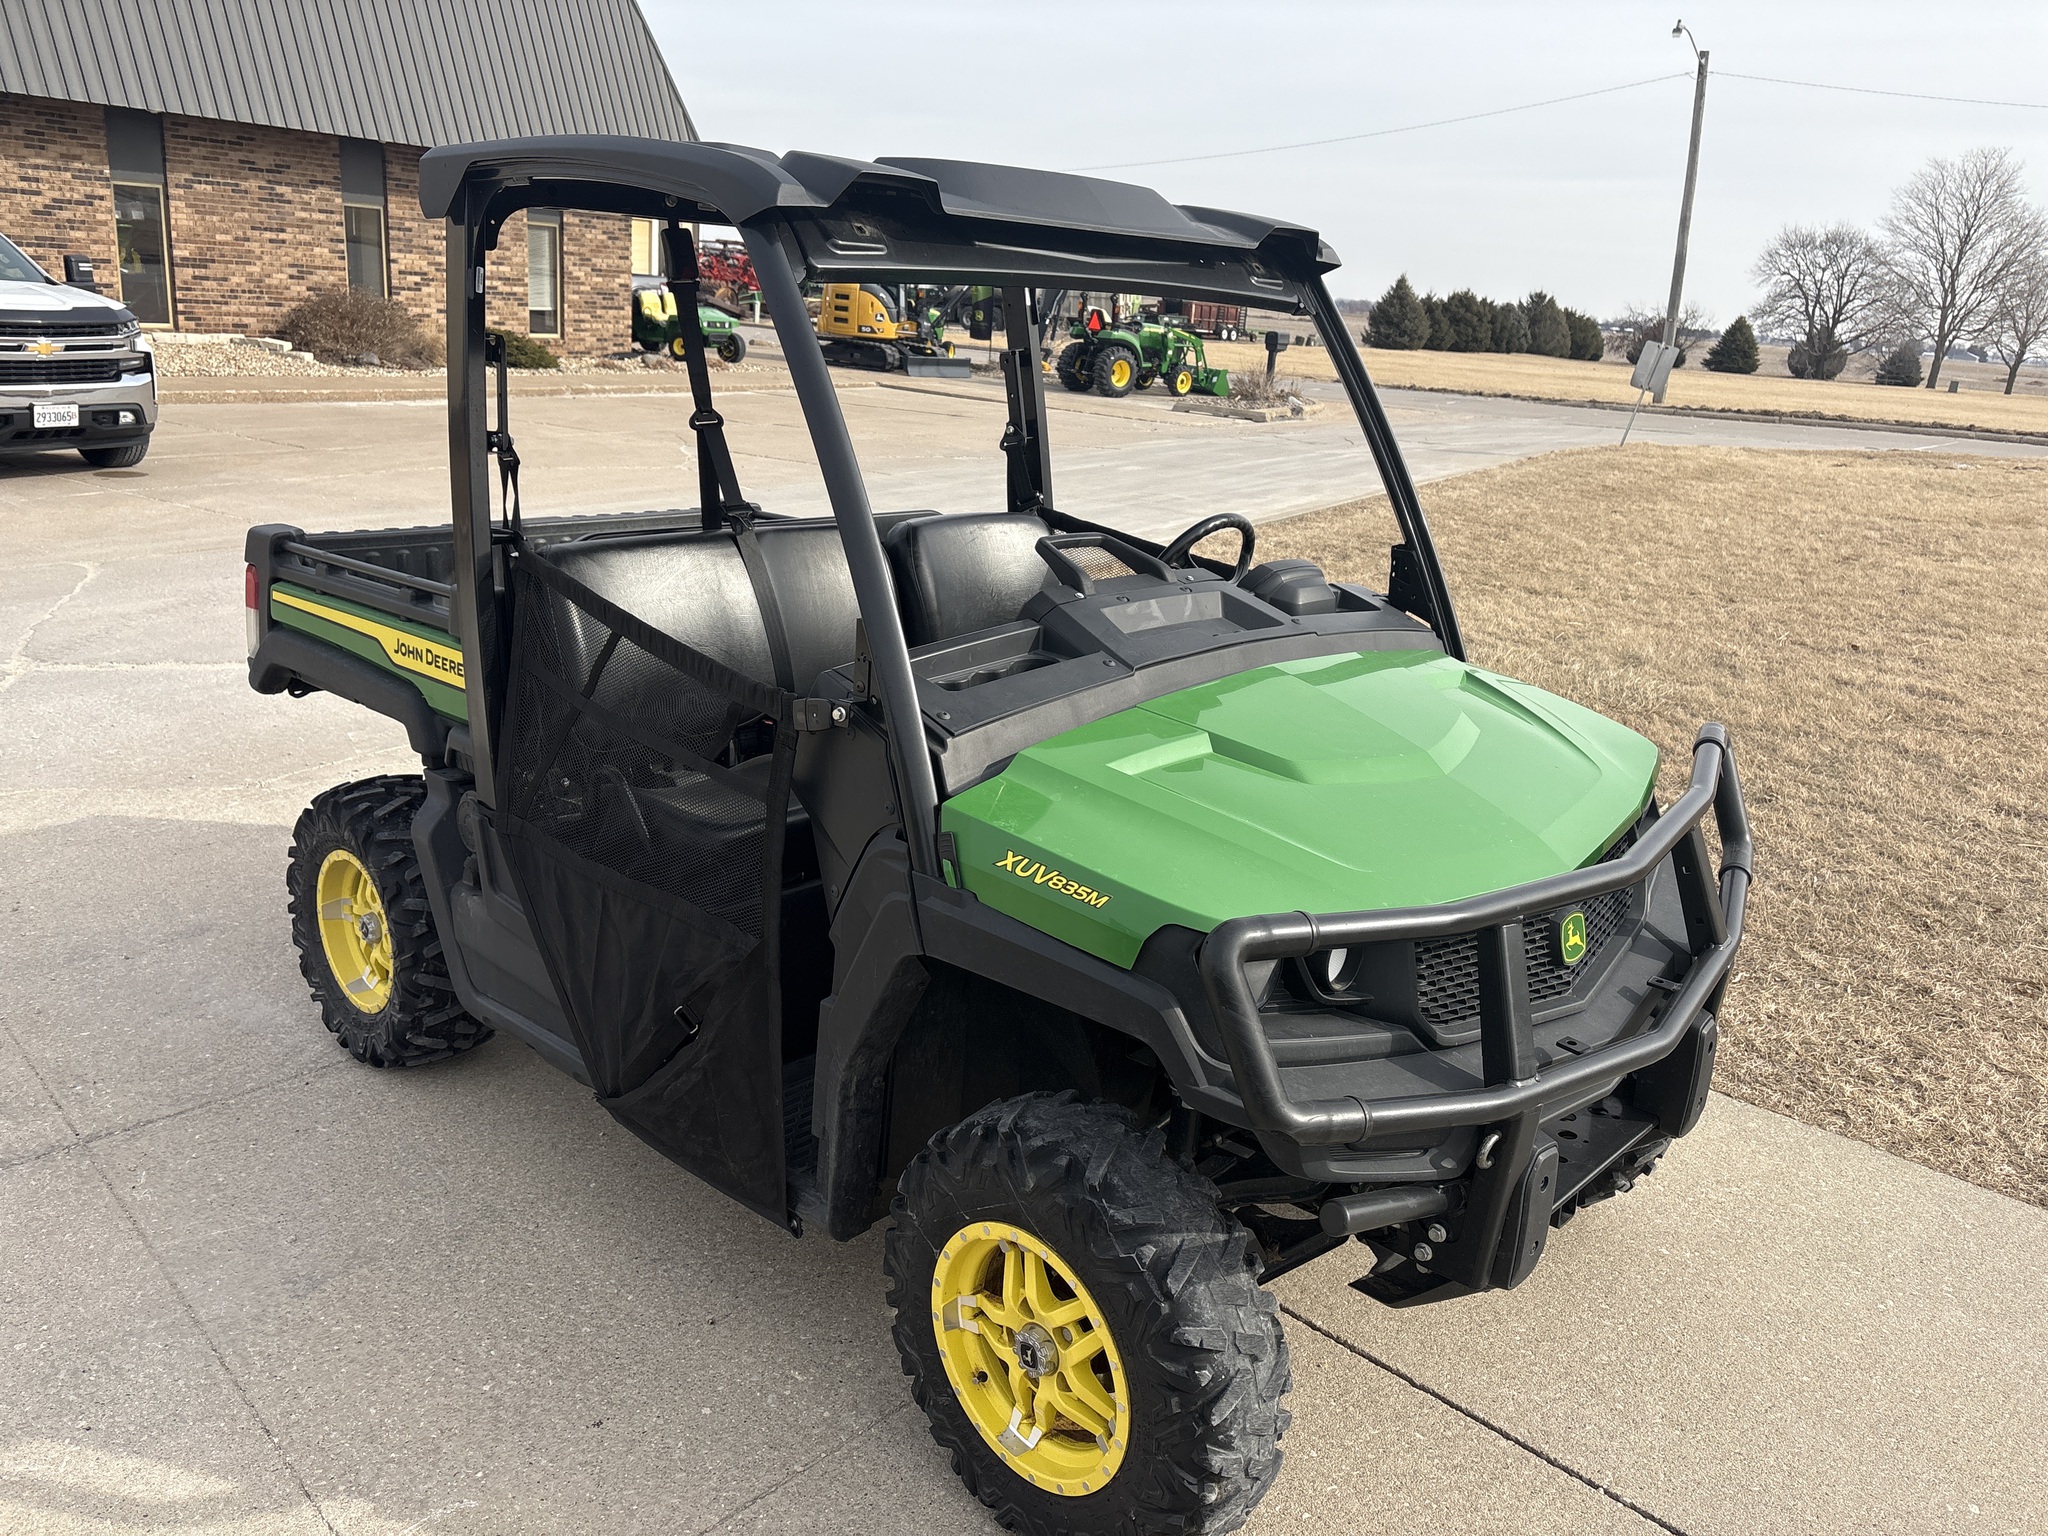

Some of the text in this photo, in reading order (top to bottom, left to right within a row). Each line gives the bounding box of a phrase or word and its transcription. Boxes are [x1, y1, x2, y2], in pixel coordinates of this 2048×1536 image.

[394, 638, 464, 677] JOHN DEERE
[993, 849, 1112, 909] XUV835M
